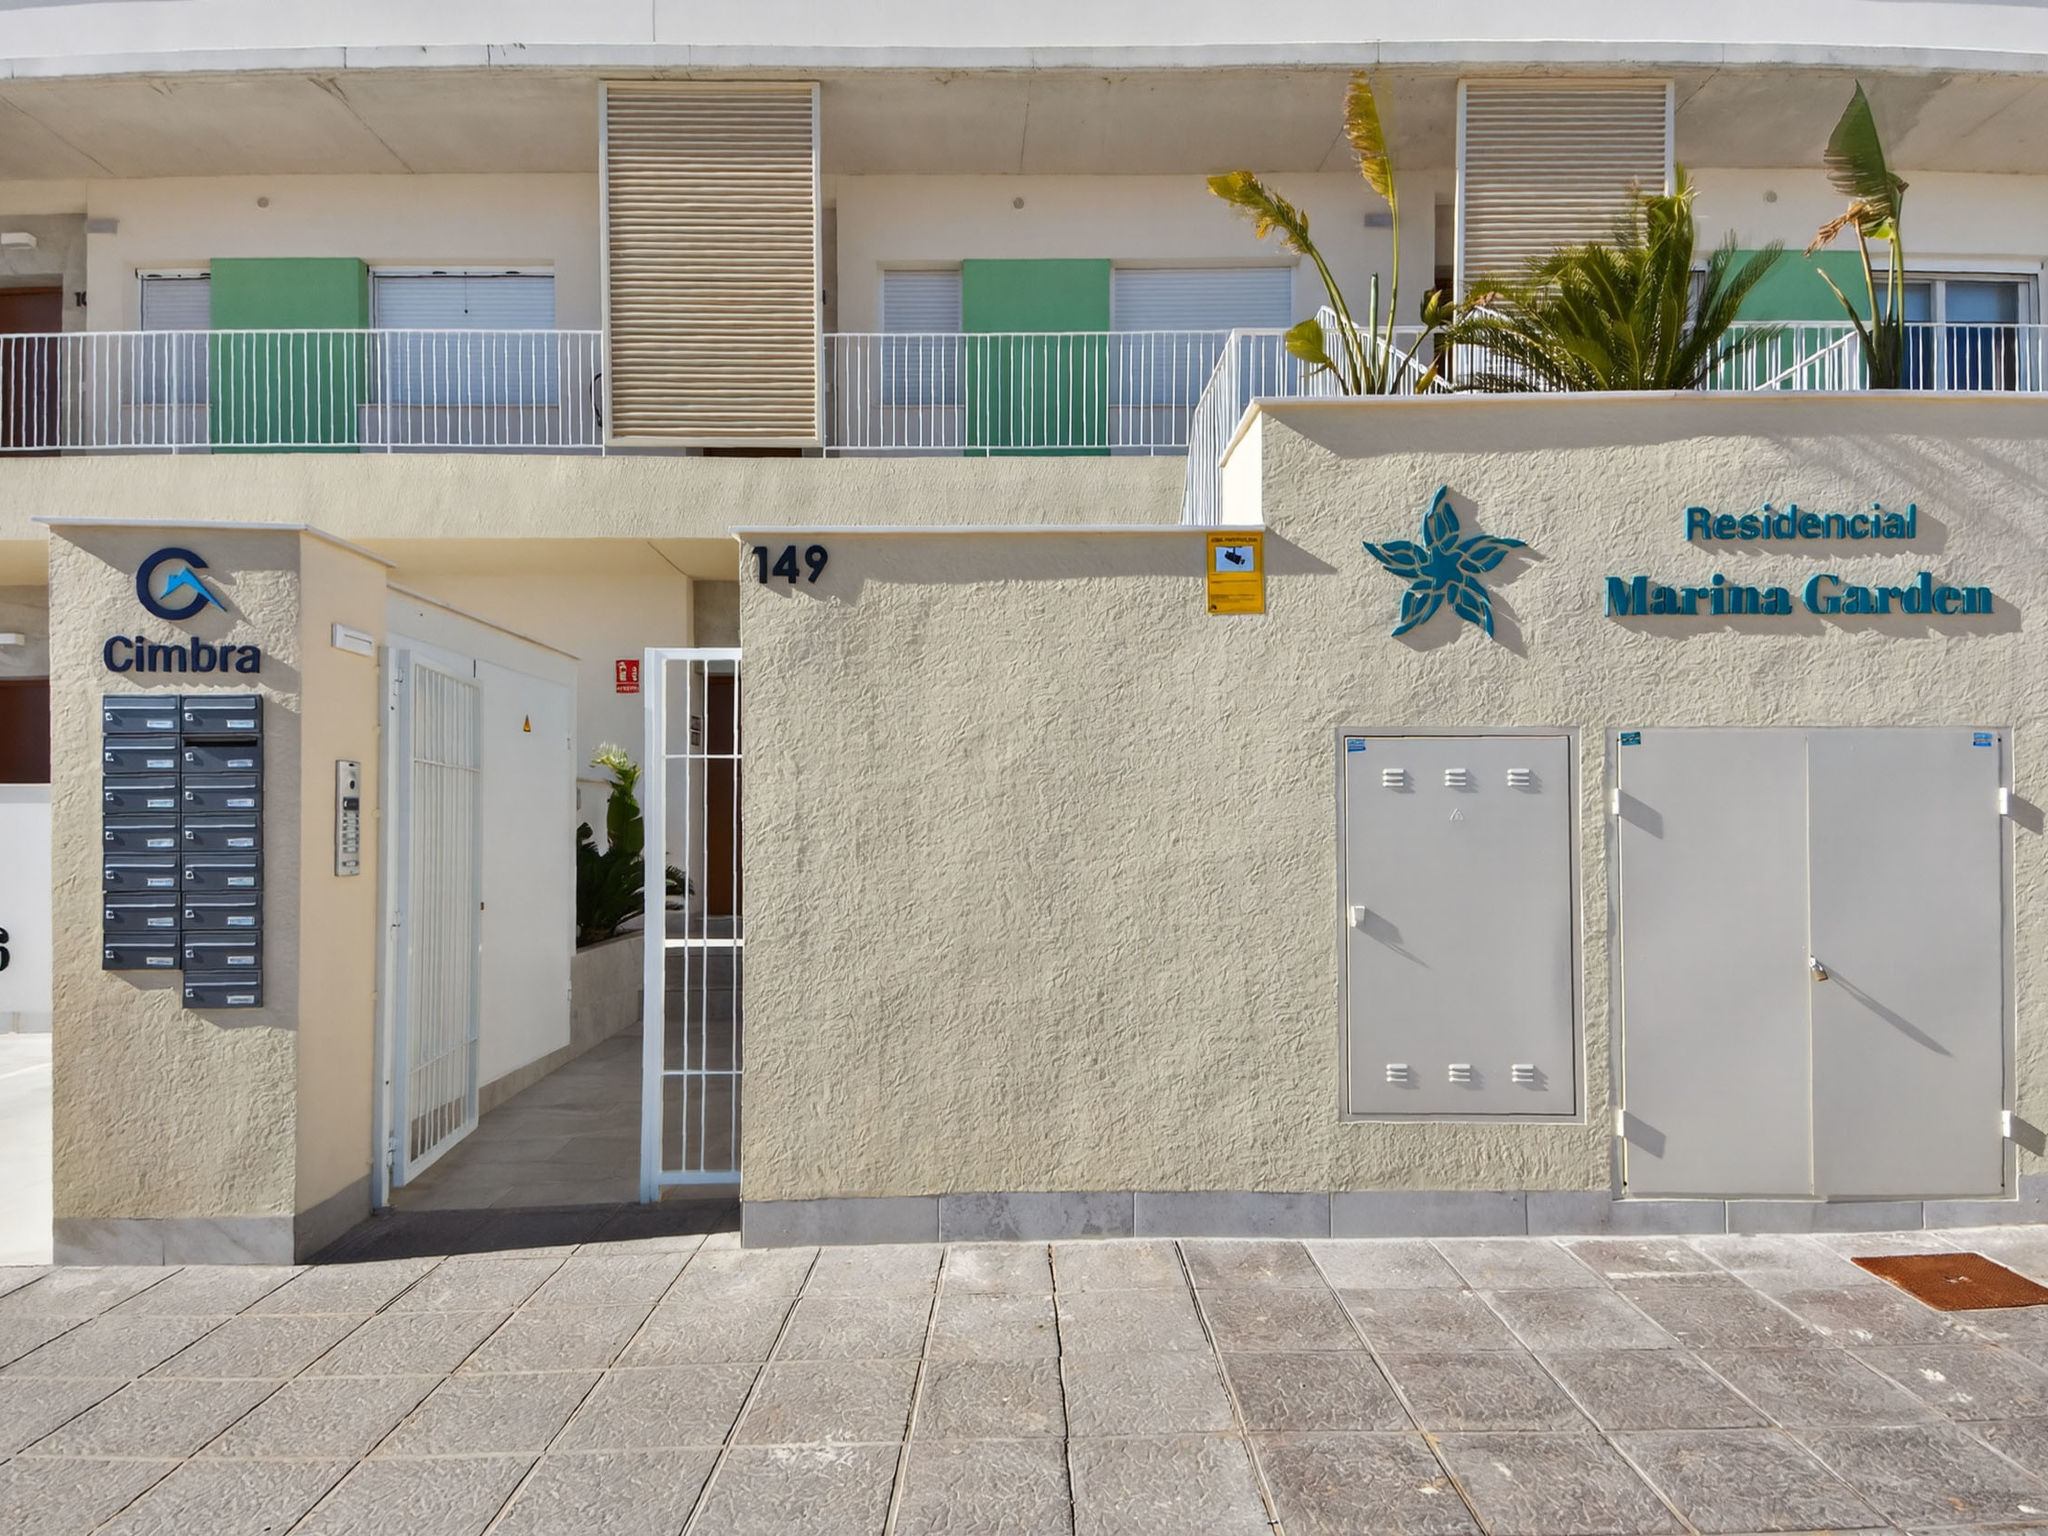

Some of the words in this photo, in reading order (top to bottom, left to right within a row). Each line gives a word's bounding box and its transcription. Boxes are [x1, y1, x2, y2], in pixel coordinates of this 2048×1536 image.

[1685, 502, 1917, 541] Residencial
[752, 544, 829, 584] 149
[1604, 573, 1793, 617] Marina
[1801, 571, 1994, 615] Garden
[103, 635, 261, 673] Cimbra
